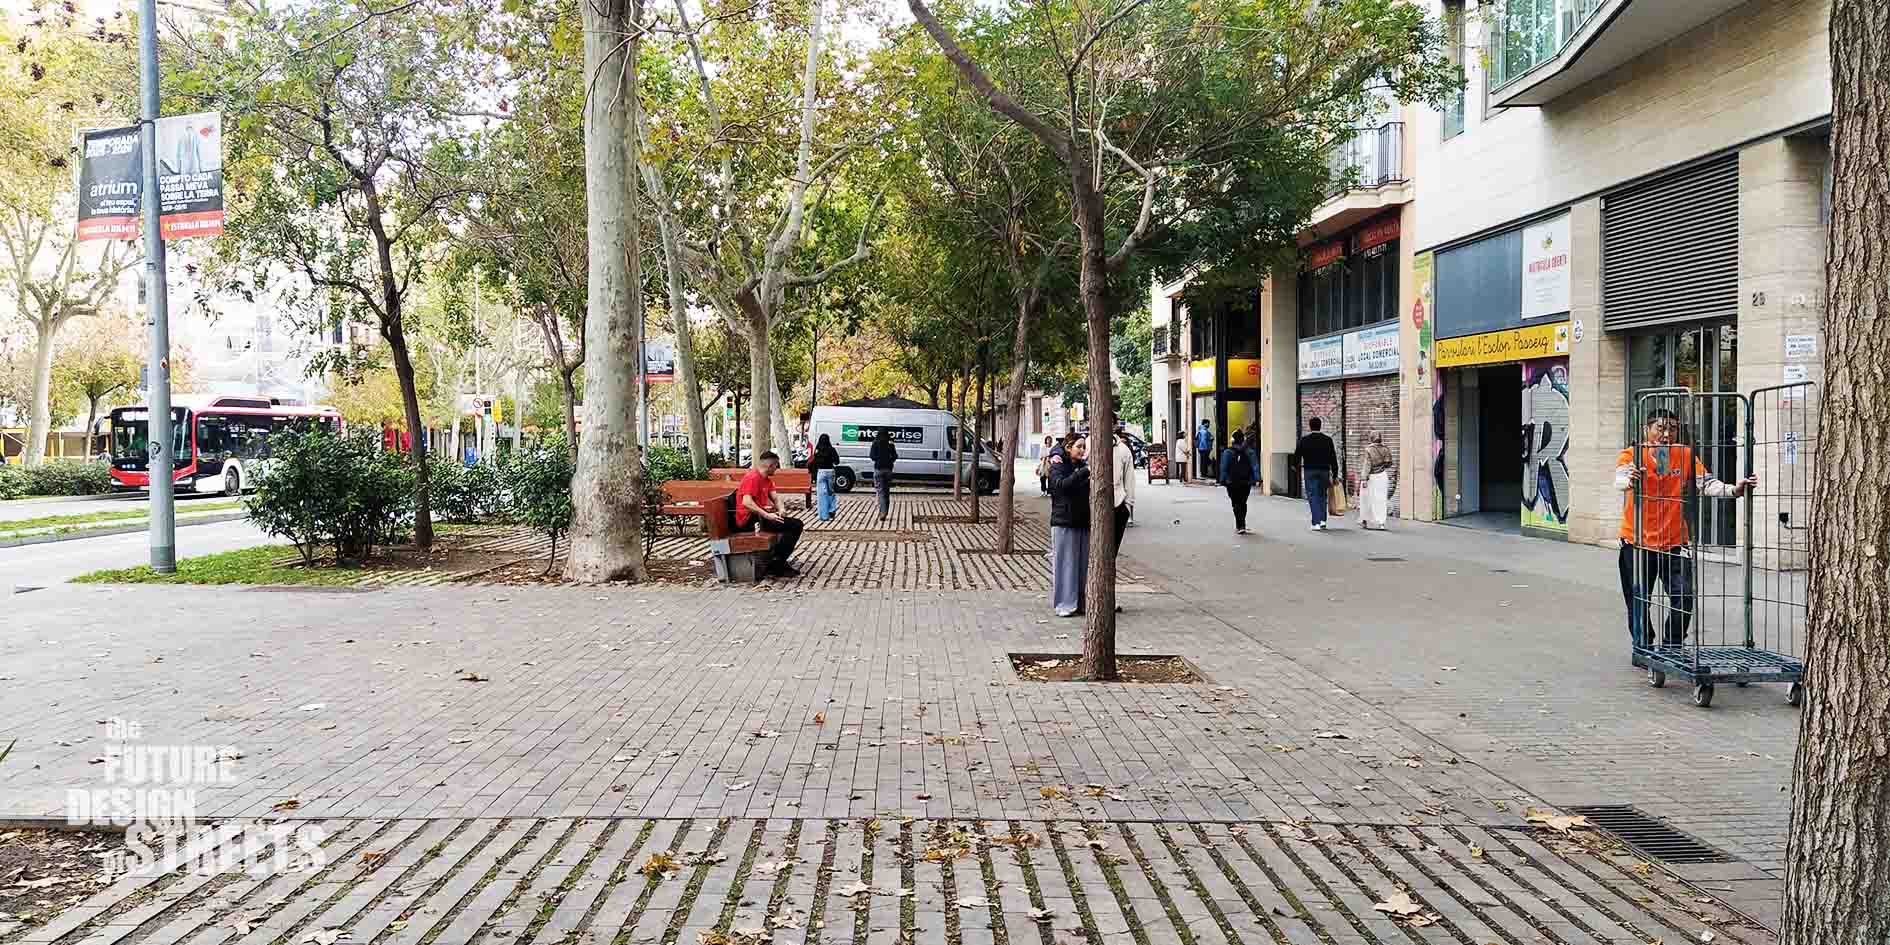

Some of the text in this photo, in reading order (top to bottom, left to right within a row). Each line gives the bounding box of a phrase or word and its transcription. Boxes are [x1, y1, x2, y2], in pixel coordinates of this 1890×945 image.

[90, 179, 138, 197] atrium
[1513, 330, 1549, 354] Passeig
[847, 428, 922, 440] enteprise
